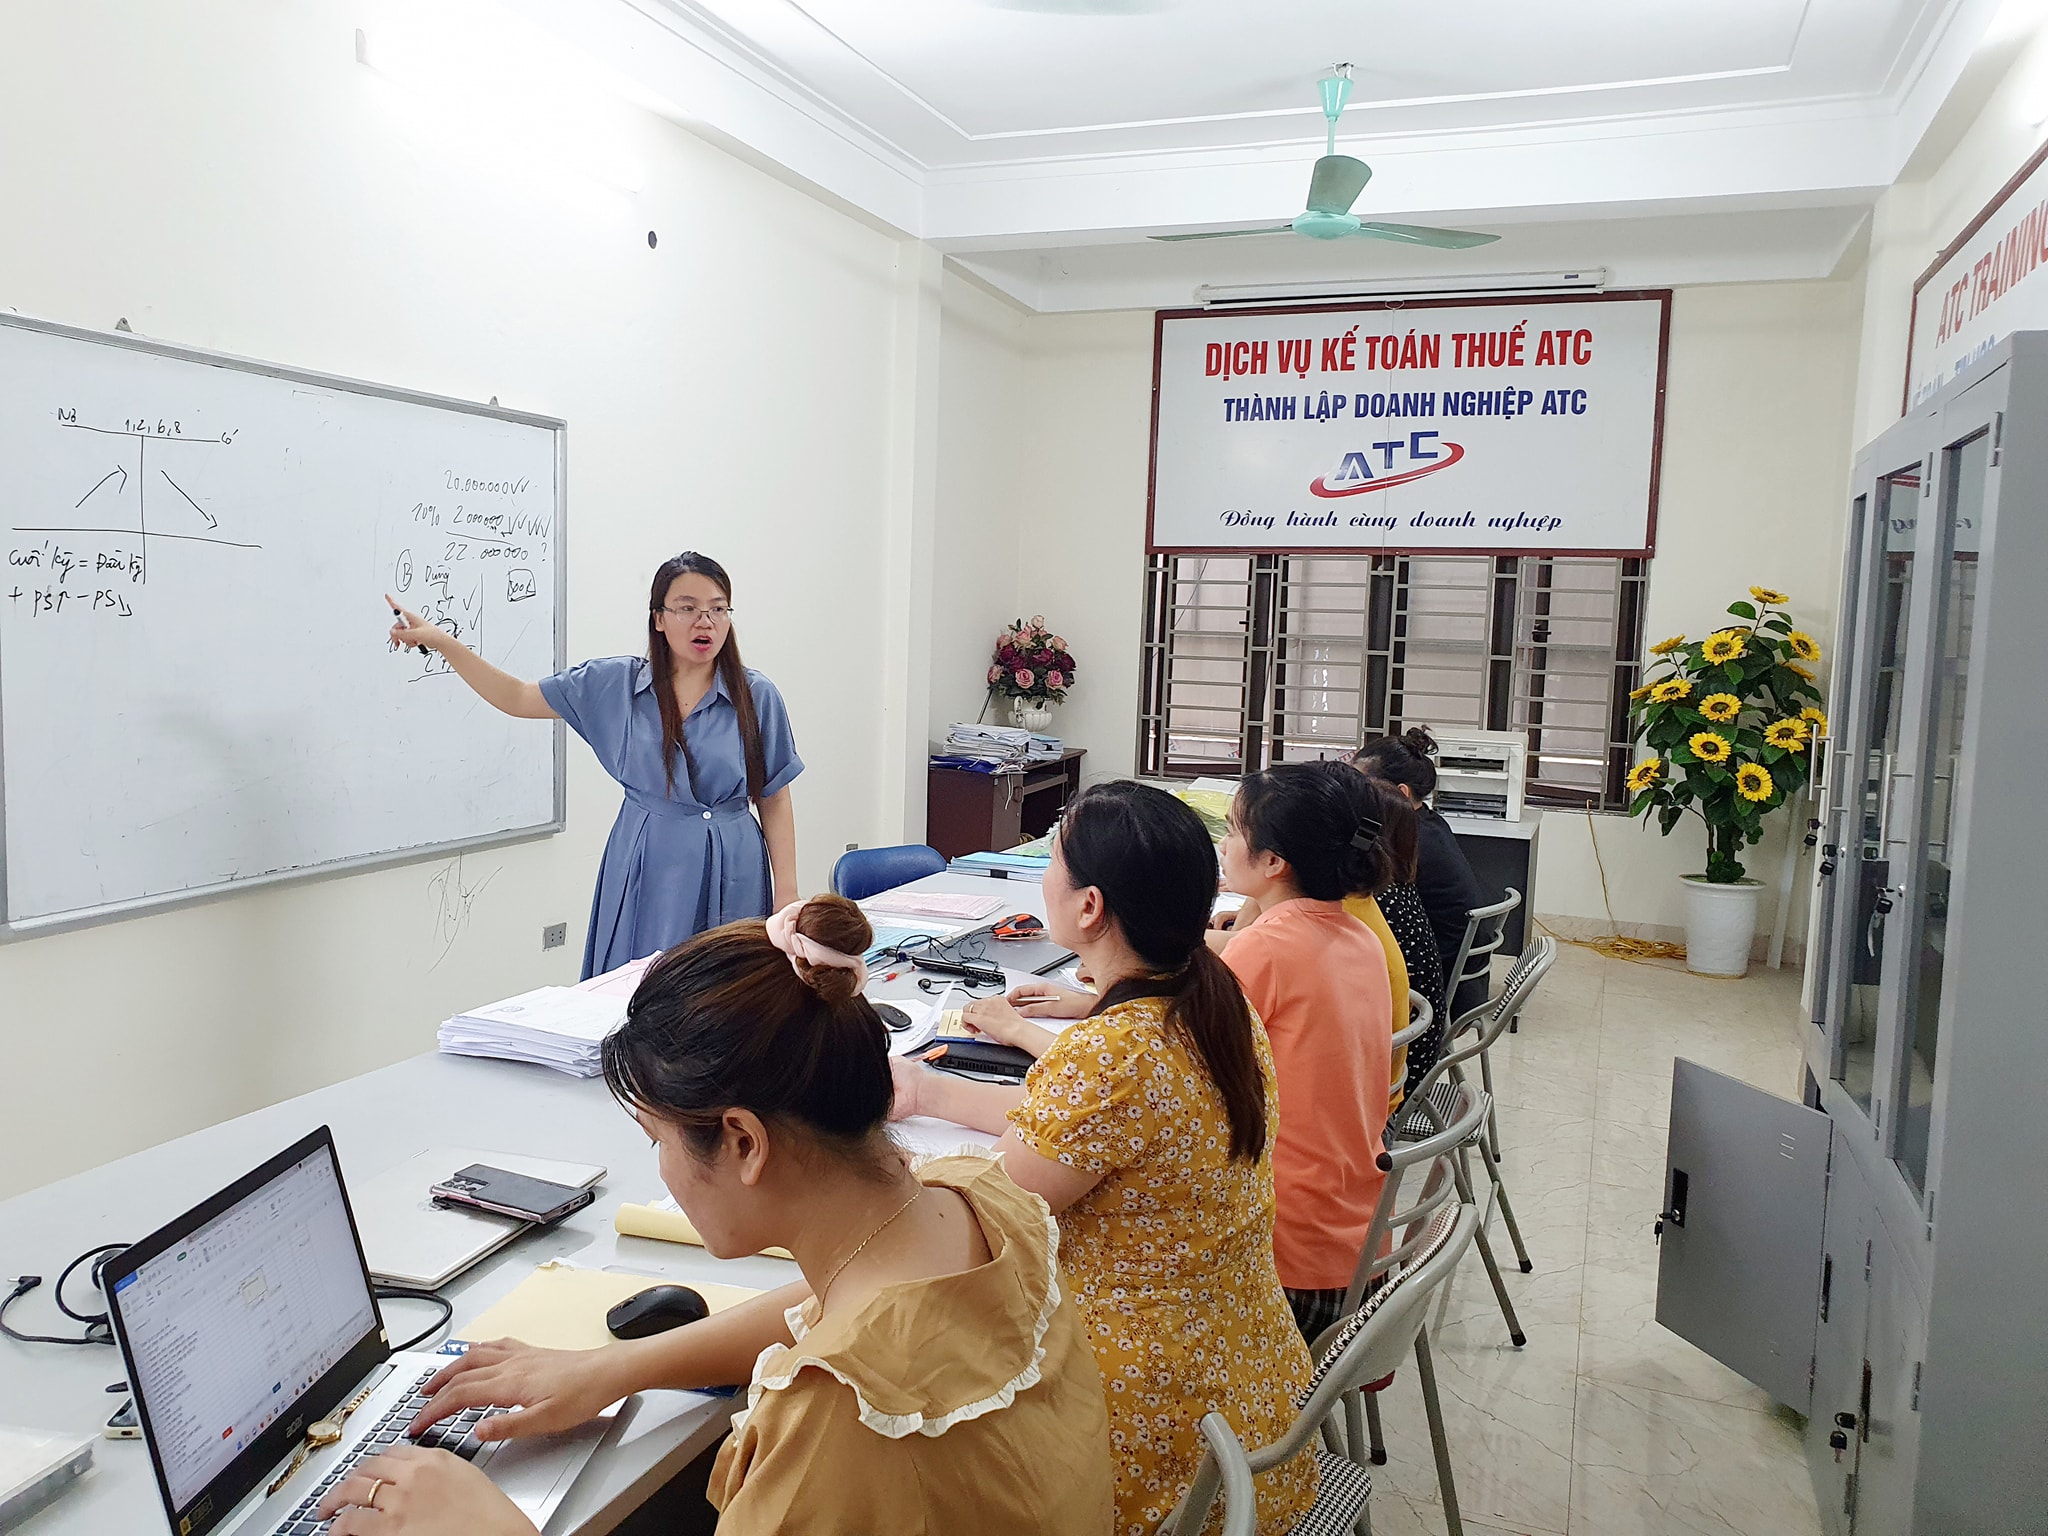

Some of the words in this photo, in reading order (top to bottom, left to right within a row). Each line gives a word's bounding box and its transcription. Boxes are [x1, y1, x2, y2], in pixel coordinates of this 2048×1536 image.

[1936, 272, 1969, 349] ATC
[1205, 341, 1268, 381] DỊCH
[1277, 339, 1312, 379] VỤ
[1321, 325, 1360, 372] KẾ
[1365, 329, 1441, 370] TOÁN
[1451, 320, 1528, 368] THUẾ
[1535, 328, 1592, 366] ATC
[1223, 393, 1296, 422] THÀNH
[1304, 391, 1347, 423] LẬP
[1355, 392, 1436, 418] DOANH
[1442, 386, 1533, 420] NGHIỆP
[1541, 389, 1587, 415] ATC
[1335, 431, 1439, 481] ATC
[1220, 509, 1276, 530] Đồng
[1286, 510, 1338, 528] hành
[1349, 511, 1399, 530] cùng
[1410, 511, 1477, 528] doanh
[1487, 511, 1563, 531] nghiệp
